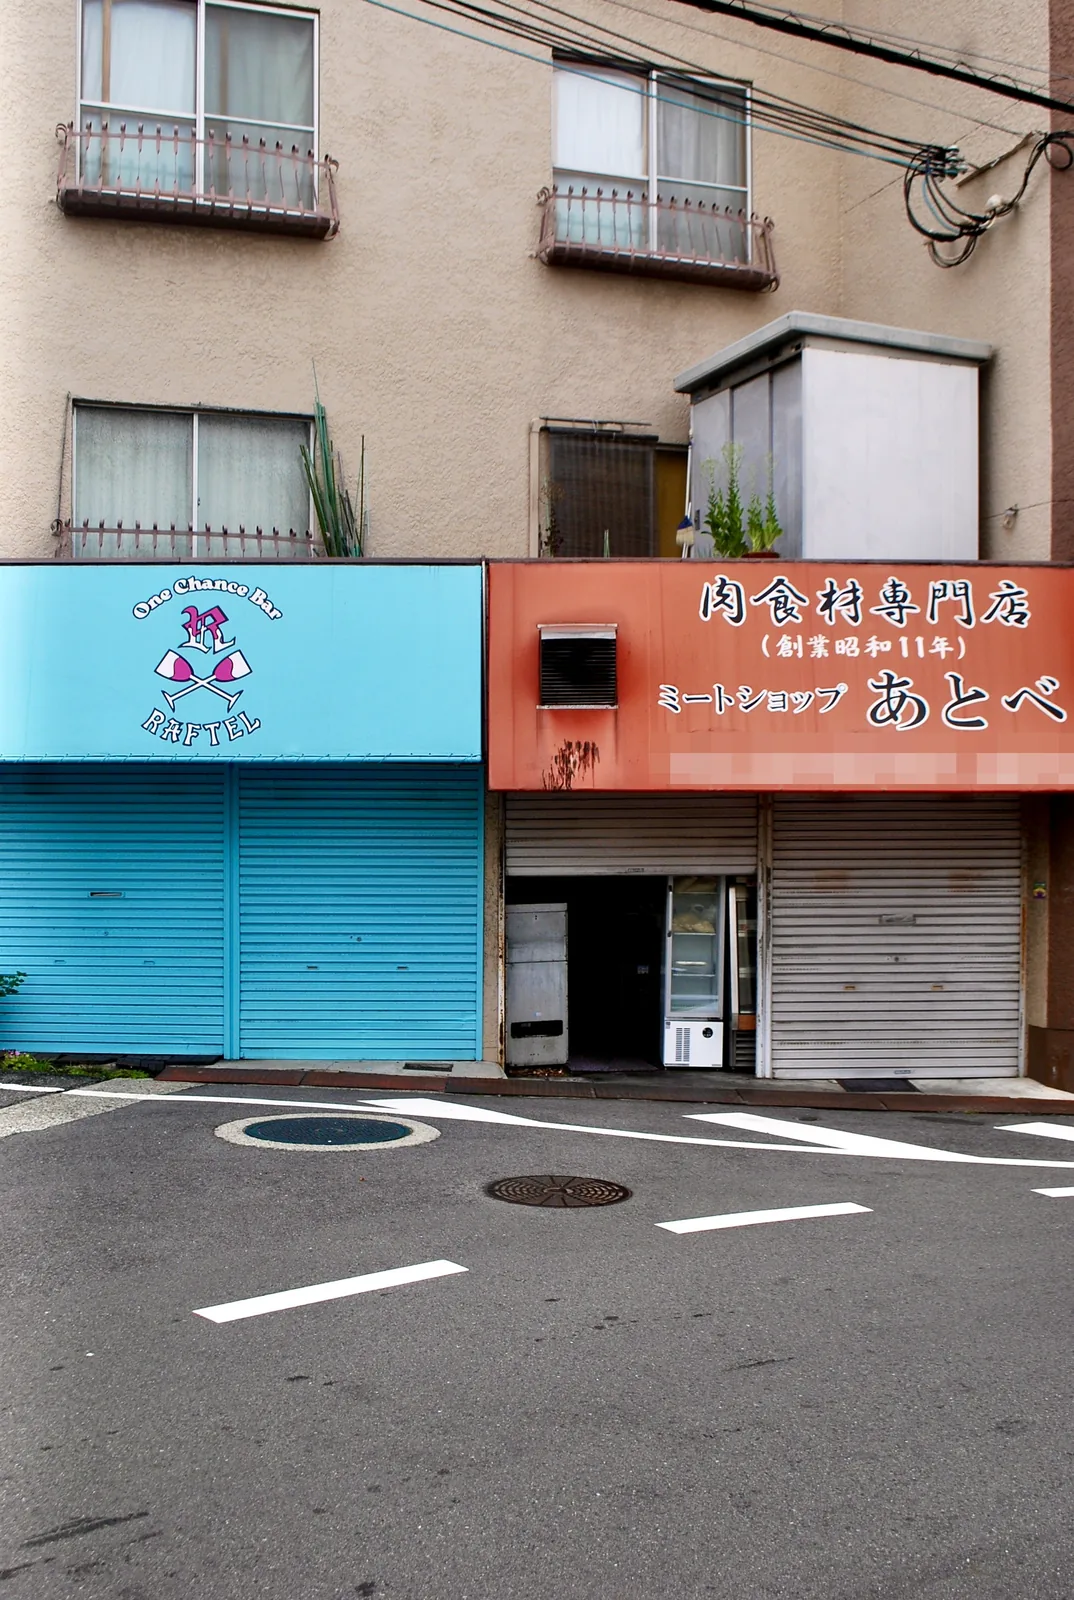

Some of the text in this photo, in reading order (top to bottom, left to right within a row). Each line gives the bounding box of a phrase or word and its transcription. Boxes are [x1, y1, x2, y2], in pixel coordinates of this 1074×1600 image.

[132, 575, 283, 620] One Chance Bar
[699, 574, 1032, 628] 肉食材専門店
[657, 668, 1068, 732] ミートショップ あとべ
[141, 707, 261, 746] RAFTEL
